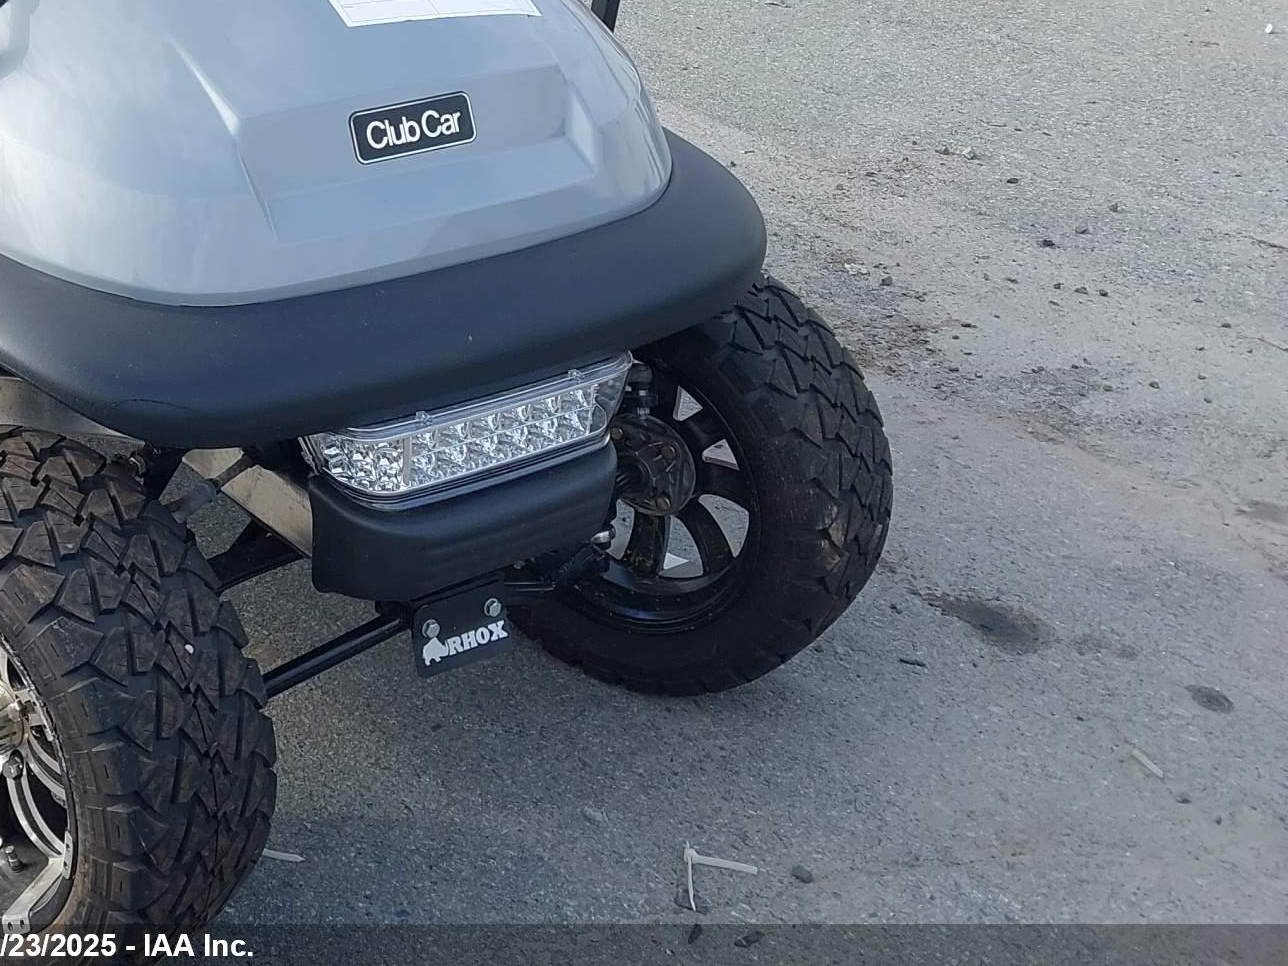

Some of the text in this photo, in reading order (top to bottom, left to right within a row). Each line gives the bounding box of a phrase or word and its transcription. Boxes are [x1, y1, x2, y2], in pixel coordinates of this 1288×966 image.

[366, 109, 461, 150] Club Car
[447, 620, 509, 656] RHOX
